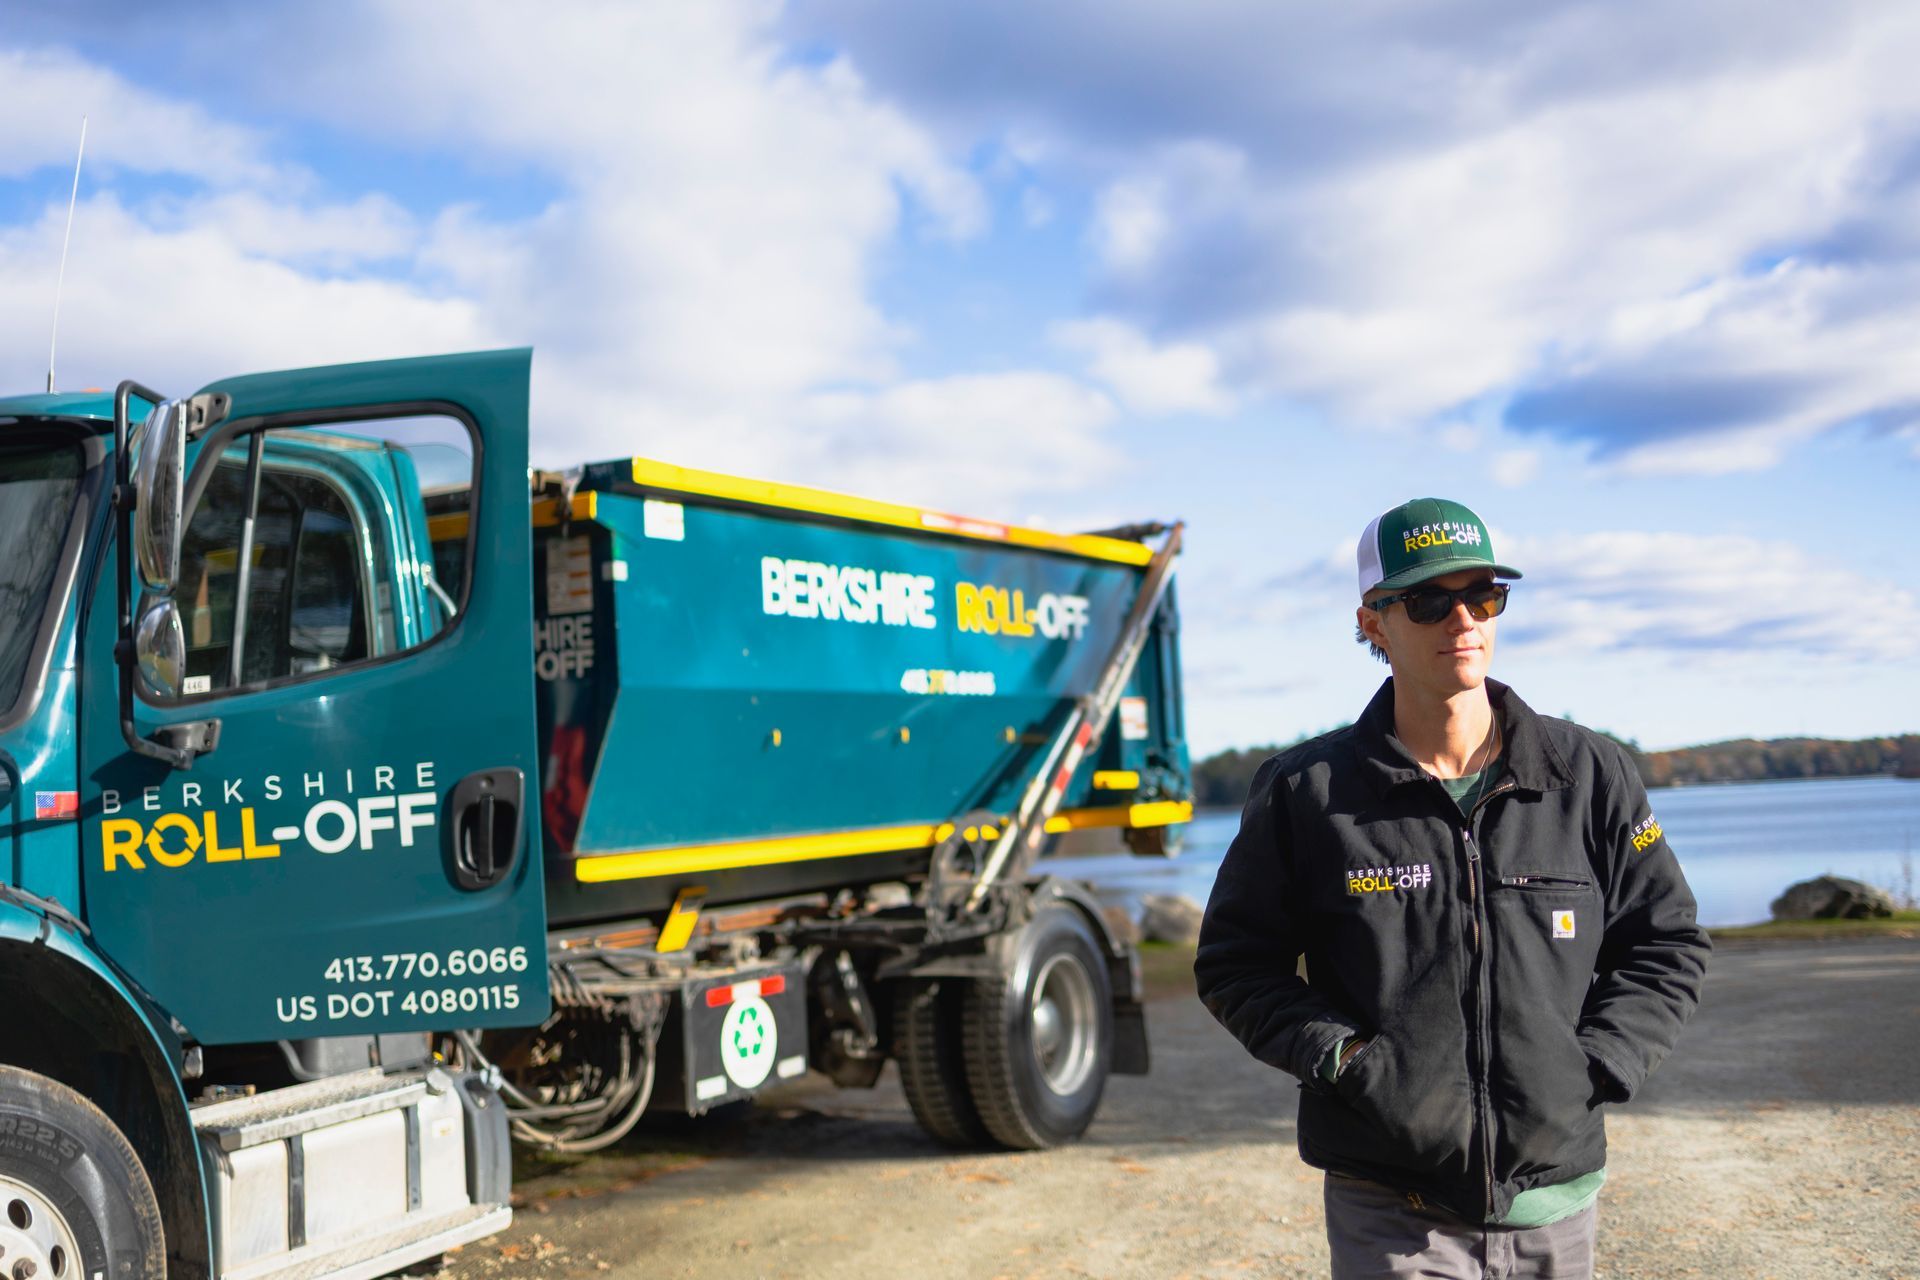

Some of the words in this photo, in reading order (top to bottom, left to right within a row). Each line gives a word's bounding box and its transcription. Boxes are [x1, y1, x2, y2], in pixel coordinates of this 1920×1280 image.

[1403, 521, 1479, 539] BERKSHIRE
[1404, 530, 1481, 553] ROLL-OFF
[761, 556, 936, 630] BERKSHIRE
[955, 581, 1089, 640] ROLL-OFF
[102, 761, 436, 814] BERKSHIRE
[101, 792, 438, 872] ROLL-OFF
[1348, 864, 1431, 879] BERKSHIRE
[1349, 872, 1431, 894] ROLL-OFF
[324, 946, 528, 984] 413.770.6066
[276, 996, 318, 1023] US
[327, 991, 394, 1020] DOT
[401, 985, 520, 1015] 4080115
